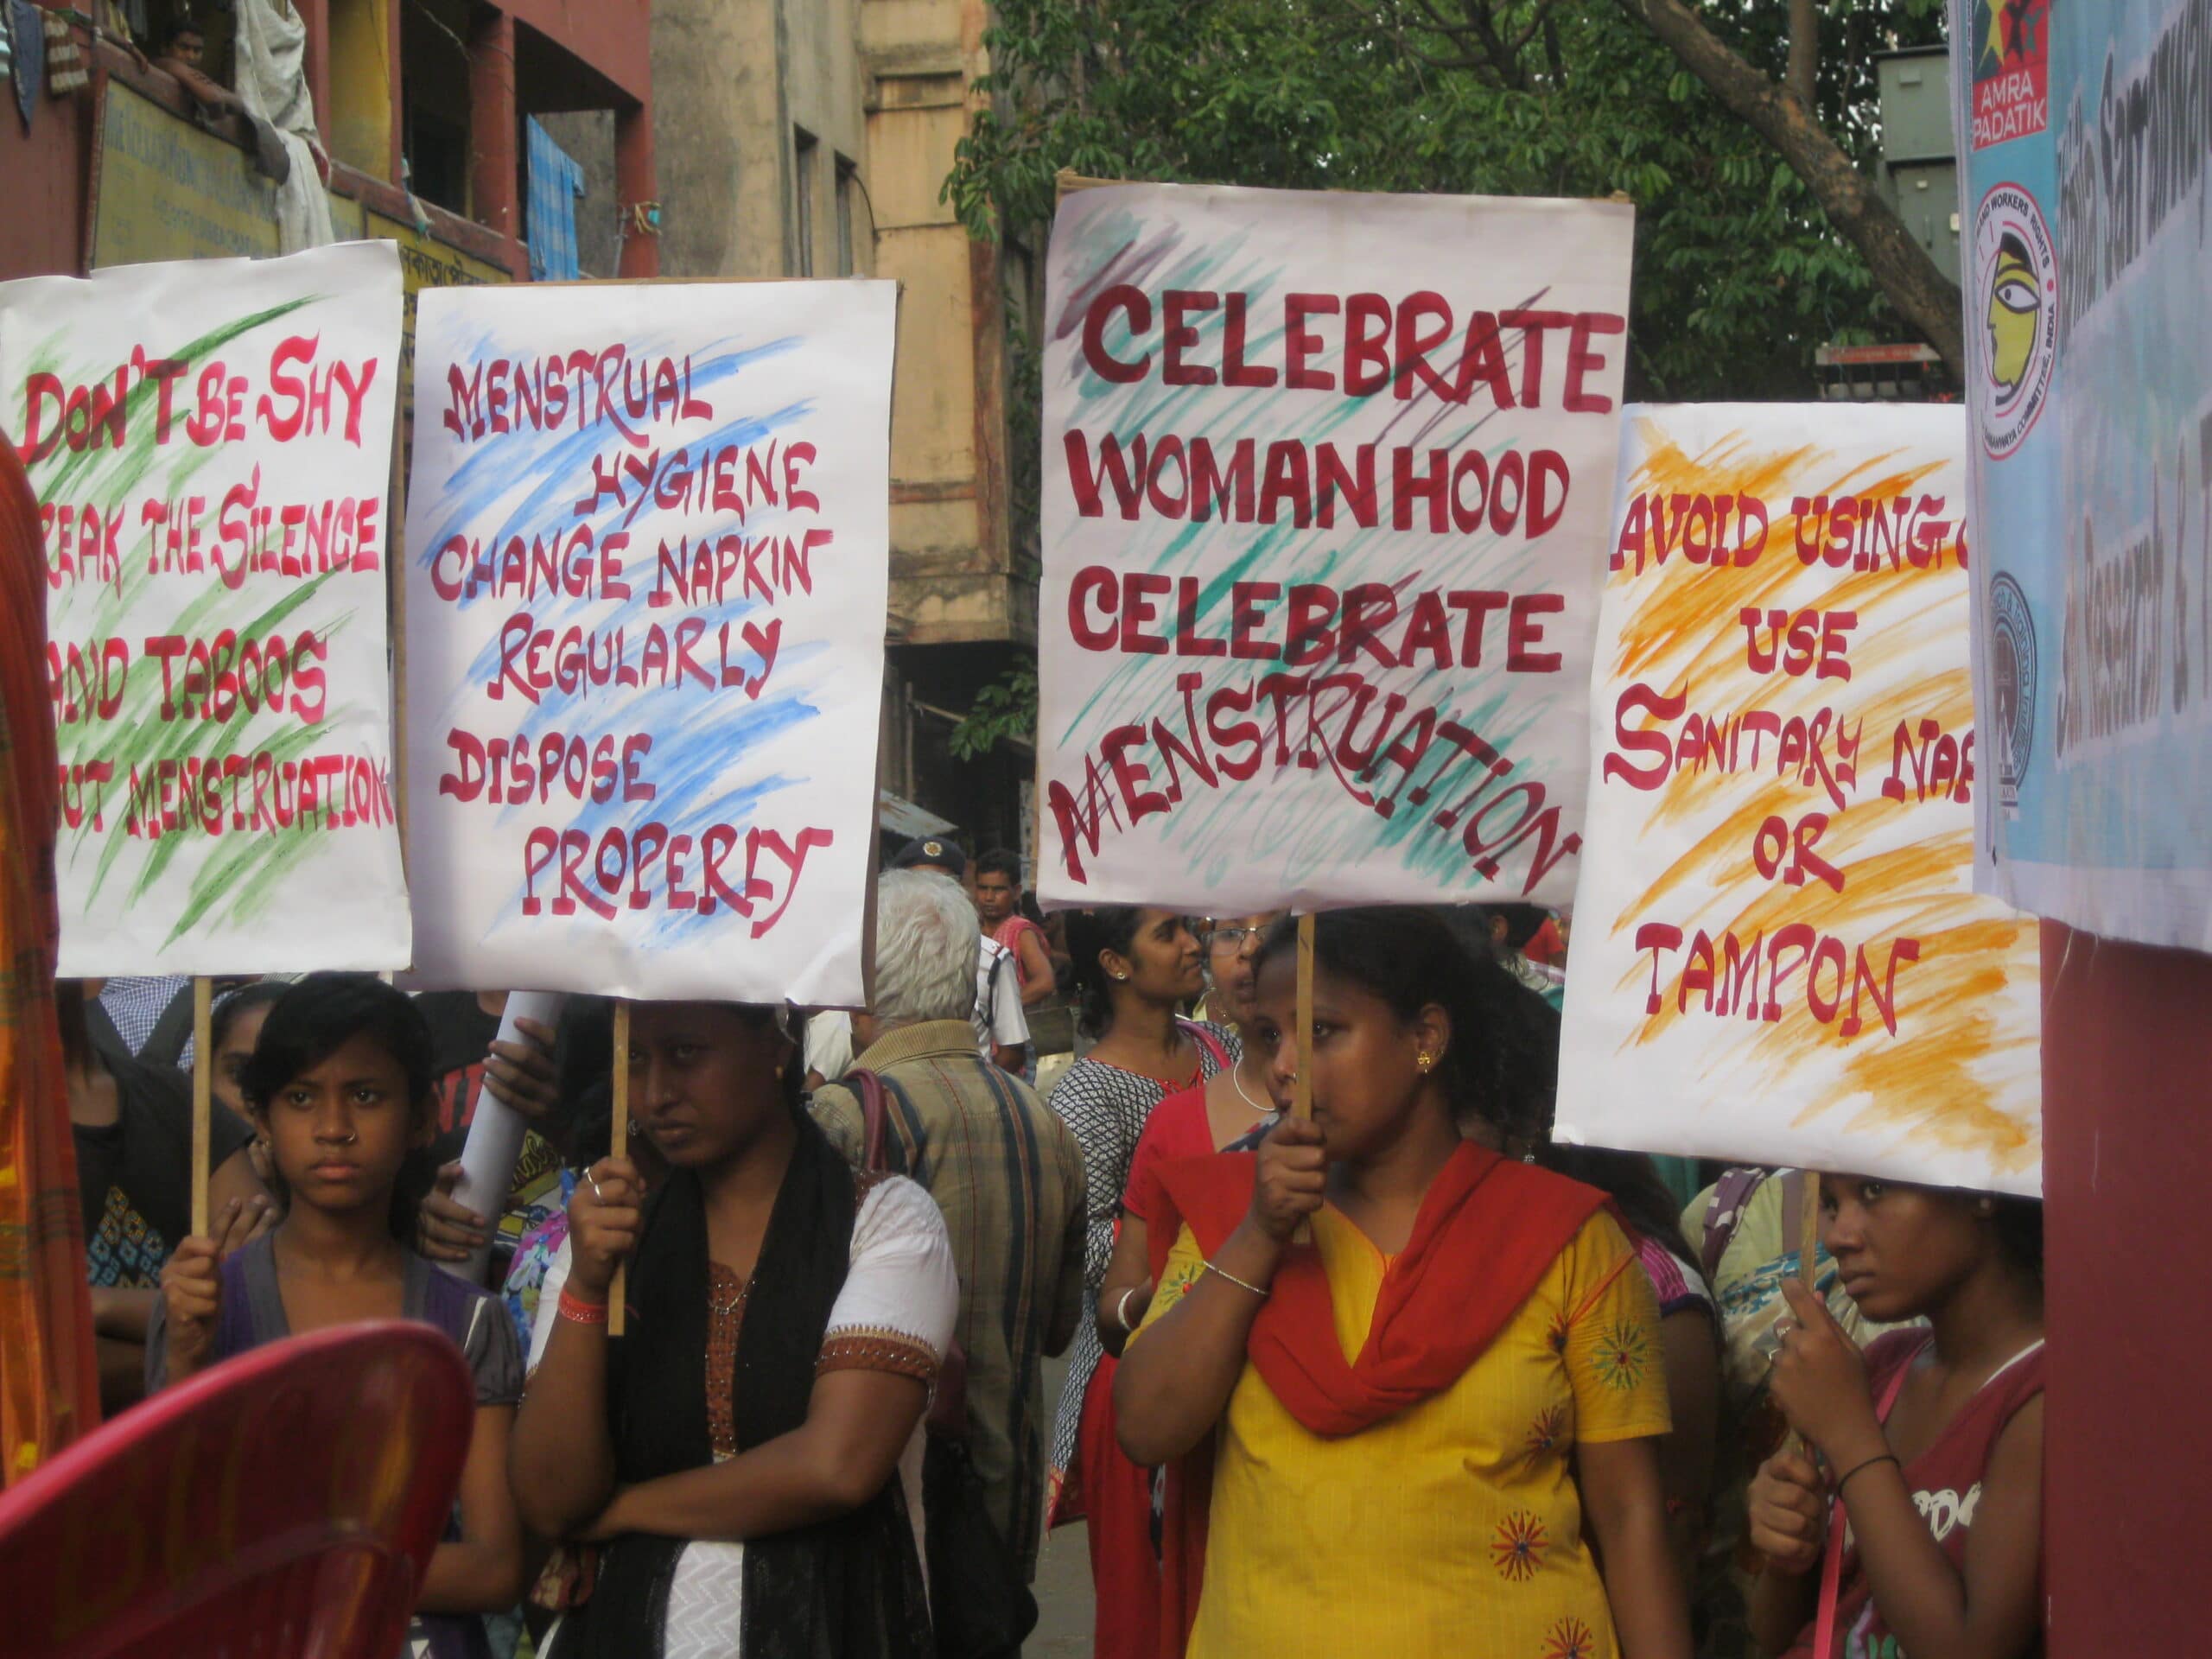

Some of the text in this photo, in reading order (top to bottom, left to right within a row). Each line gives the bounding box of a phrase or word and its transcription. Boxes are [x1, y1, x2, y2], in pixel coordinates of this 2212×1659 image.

[1974, 97, 2046, 146] PADATIK
[1981, 70, 2034, 113] AMRA
[1990, 193, 2029, 217] WORKERS
[2031, 213, 2050, 269] RIGHTS
[1082, 285, 1625, 414] CELEBRATE
[2045, 302, 2055, 348] INDIA
[15, 343, 189, 465] DON'T
[186, 361, 249, 448] BE
[257, 329, 378, 448] SHY
[444, 343, 714, 449] MENSTRUAL
[574, 438, 820, 529] HYGIENE
[41, 461, 379, 600] REAK THE SILENCE
[431, 524, 834, 608] CHANGE NAPKIN
[1609, 490, 1770, 576] AVOID
[1790, 494, 1951, 573] USING
[487, 612, 782, 705] REGULARLY
[1068, 565, 1565, 673] CELEBRATE
[1739, 607, 1859, 683] USE
[144, 628, 327, 724] TABOOS
[440, 728, 657, 805] DISPOSE
[1047, 671, 1583, 897] MENSTRUATION
[1604, 678, 1974, 811] SANITARY NAP
[127, 751, 395, 840] MENSTRUATION
[522, 822, 834, 939] PROPERLY
[1753, 812, 1846, 893] OR
[1635, 923, 1921, 1037] TAMPON
